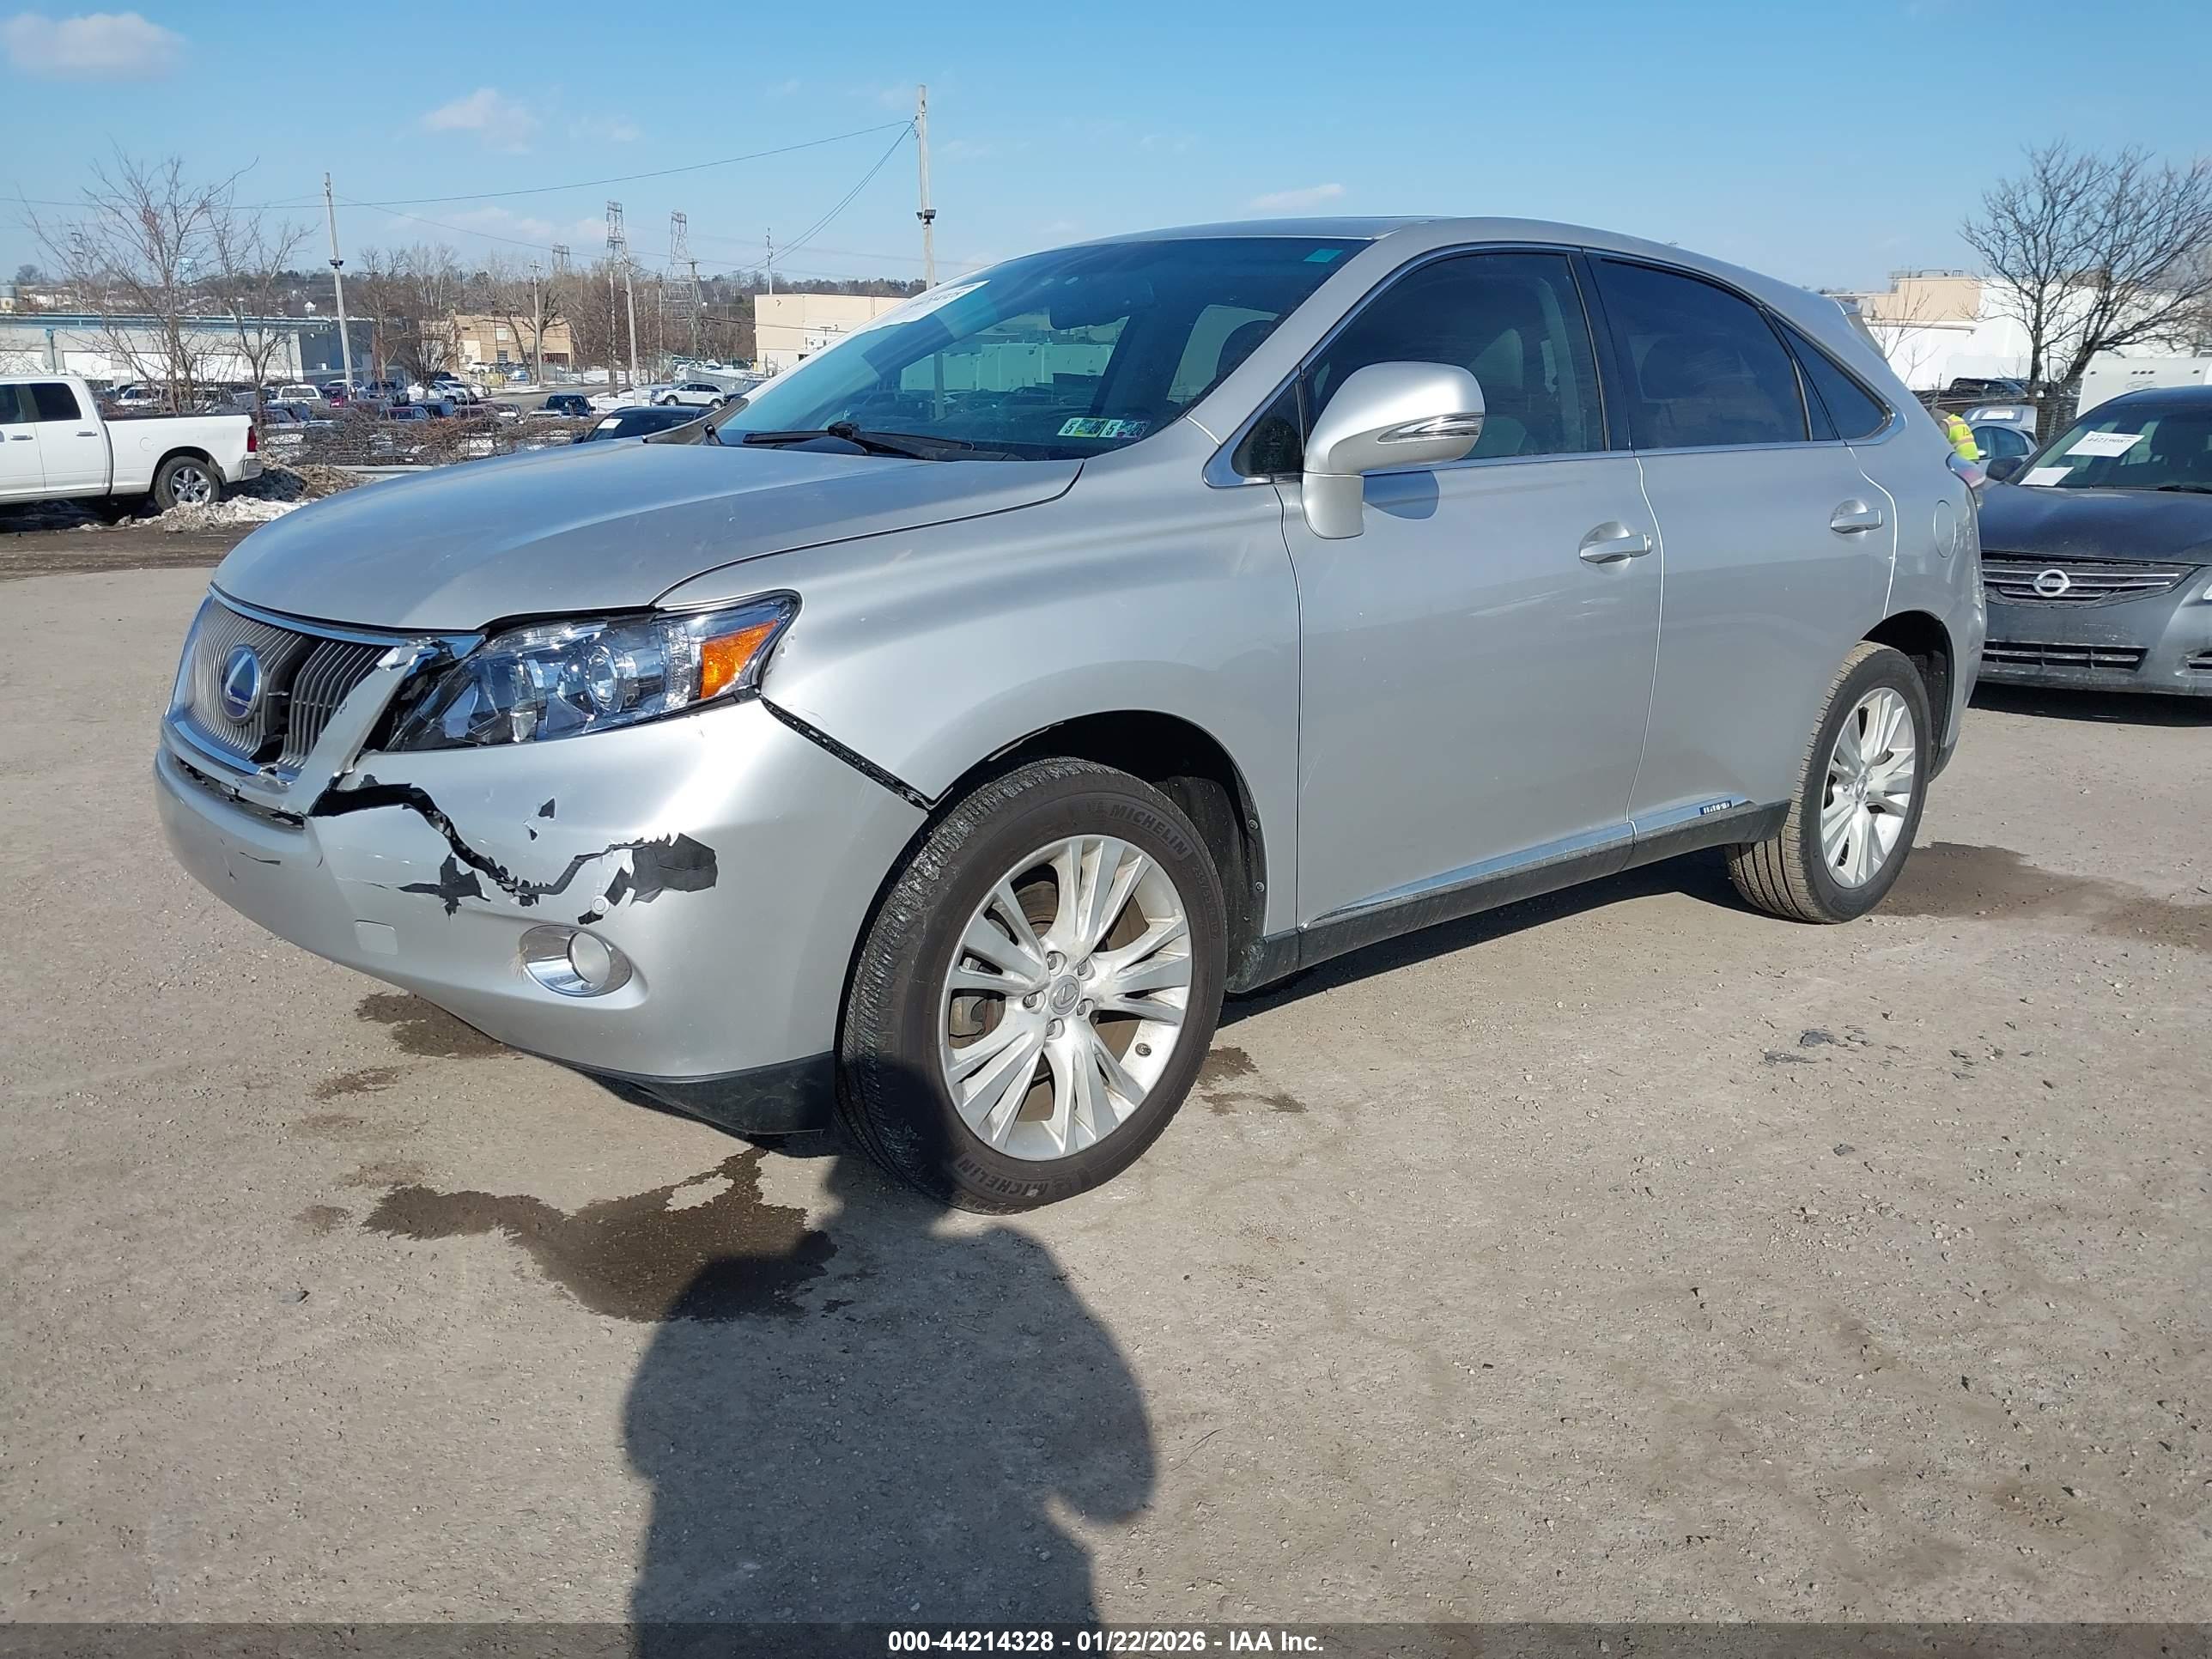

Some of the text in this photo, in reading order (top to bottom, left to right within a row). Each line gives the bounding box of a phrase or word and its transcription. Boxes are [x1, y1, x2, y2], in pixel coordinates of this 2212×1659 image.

[1106, 422, 1119, 435] 5
[1109, 804, 1189, 856] MICHELIN
[957, 1157, 1049, 1197] MICHELIN
